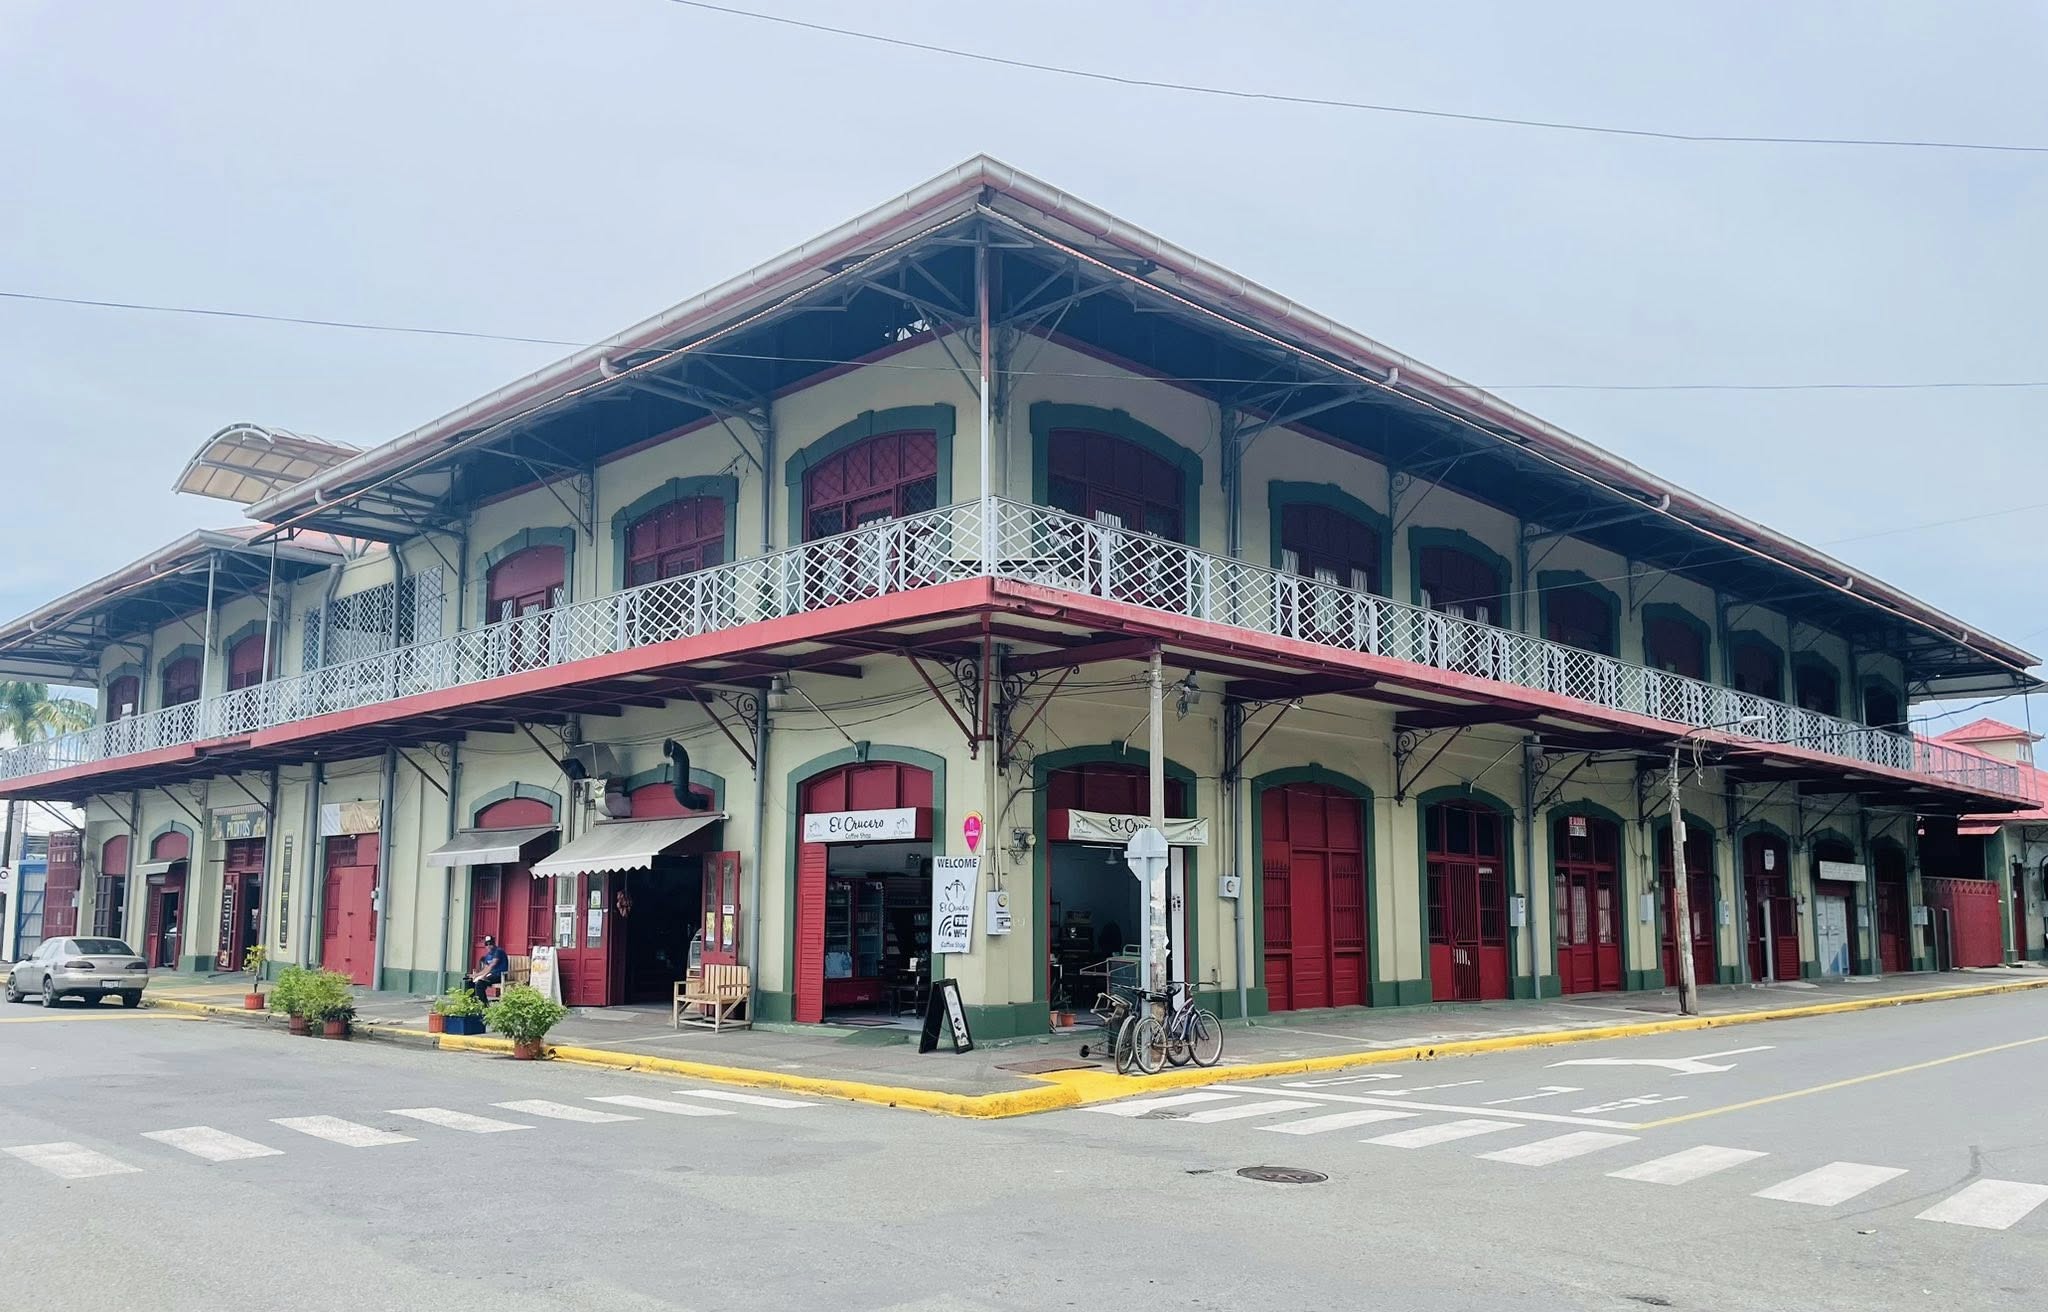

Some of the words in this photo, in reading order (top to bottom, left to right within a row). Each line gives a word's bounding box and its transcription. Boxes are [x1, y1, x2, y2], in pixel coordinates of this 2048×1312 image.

[829, 816, 841, 833] El
[844, 816, 884, 832] Crucero
[1108, 817, 1124, 833] El
[1124, 818, 1151, 833] Cruc
[845, 832, 859, 840] Coffee
[937, 858, 977, 869] WELCOME
[939, 902, 947, 912] El
